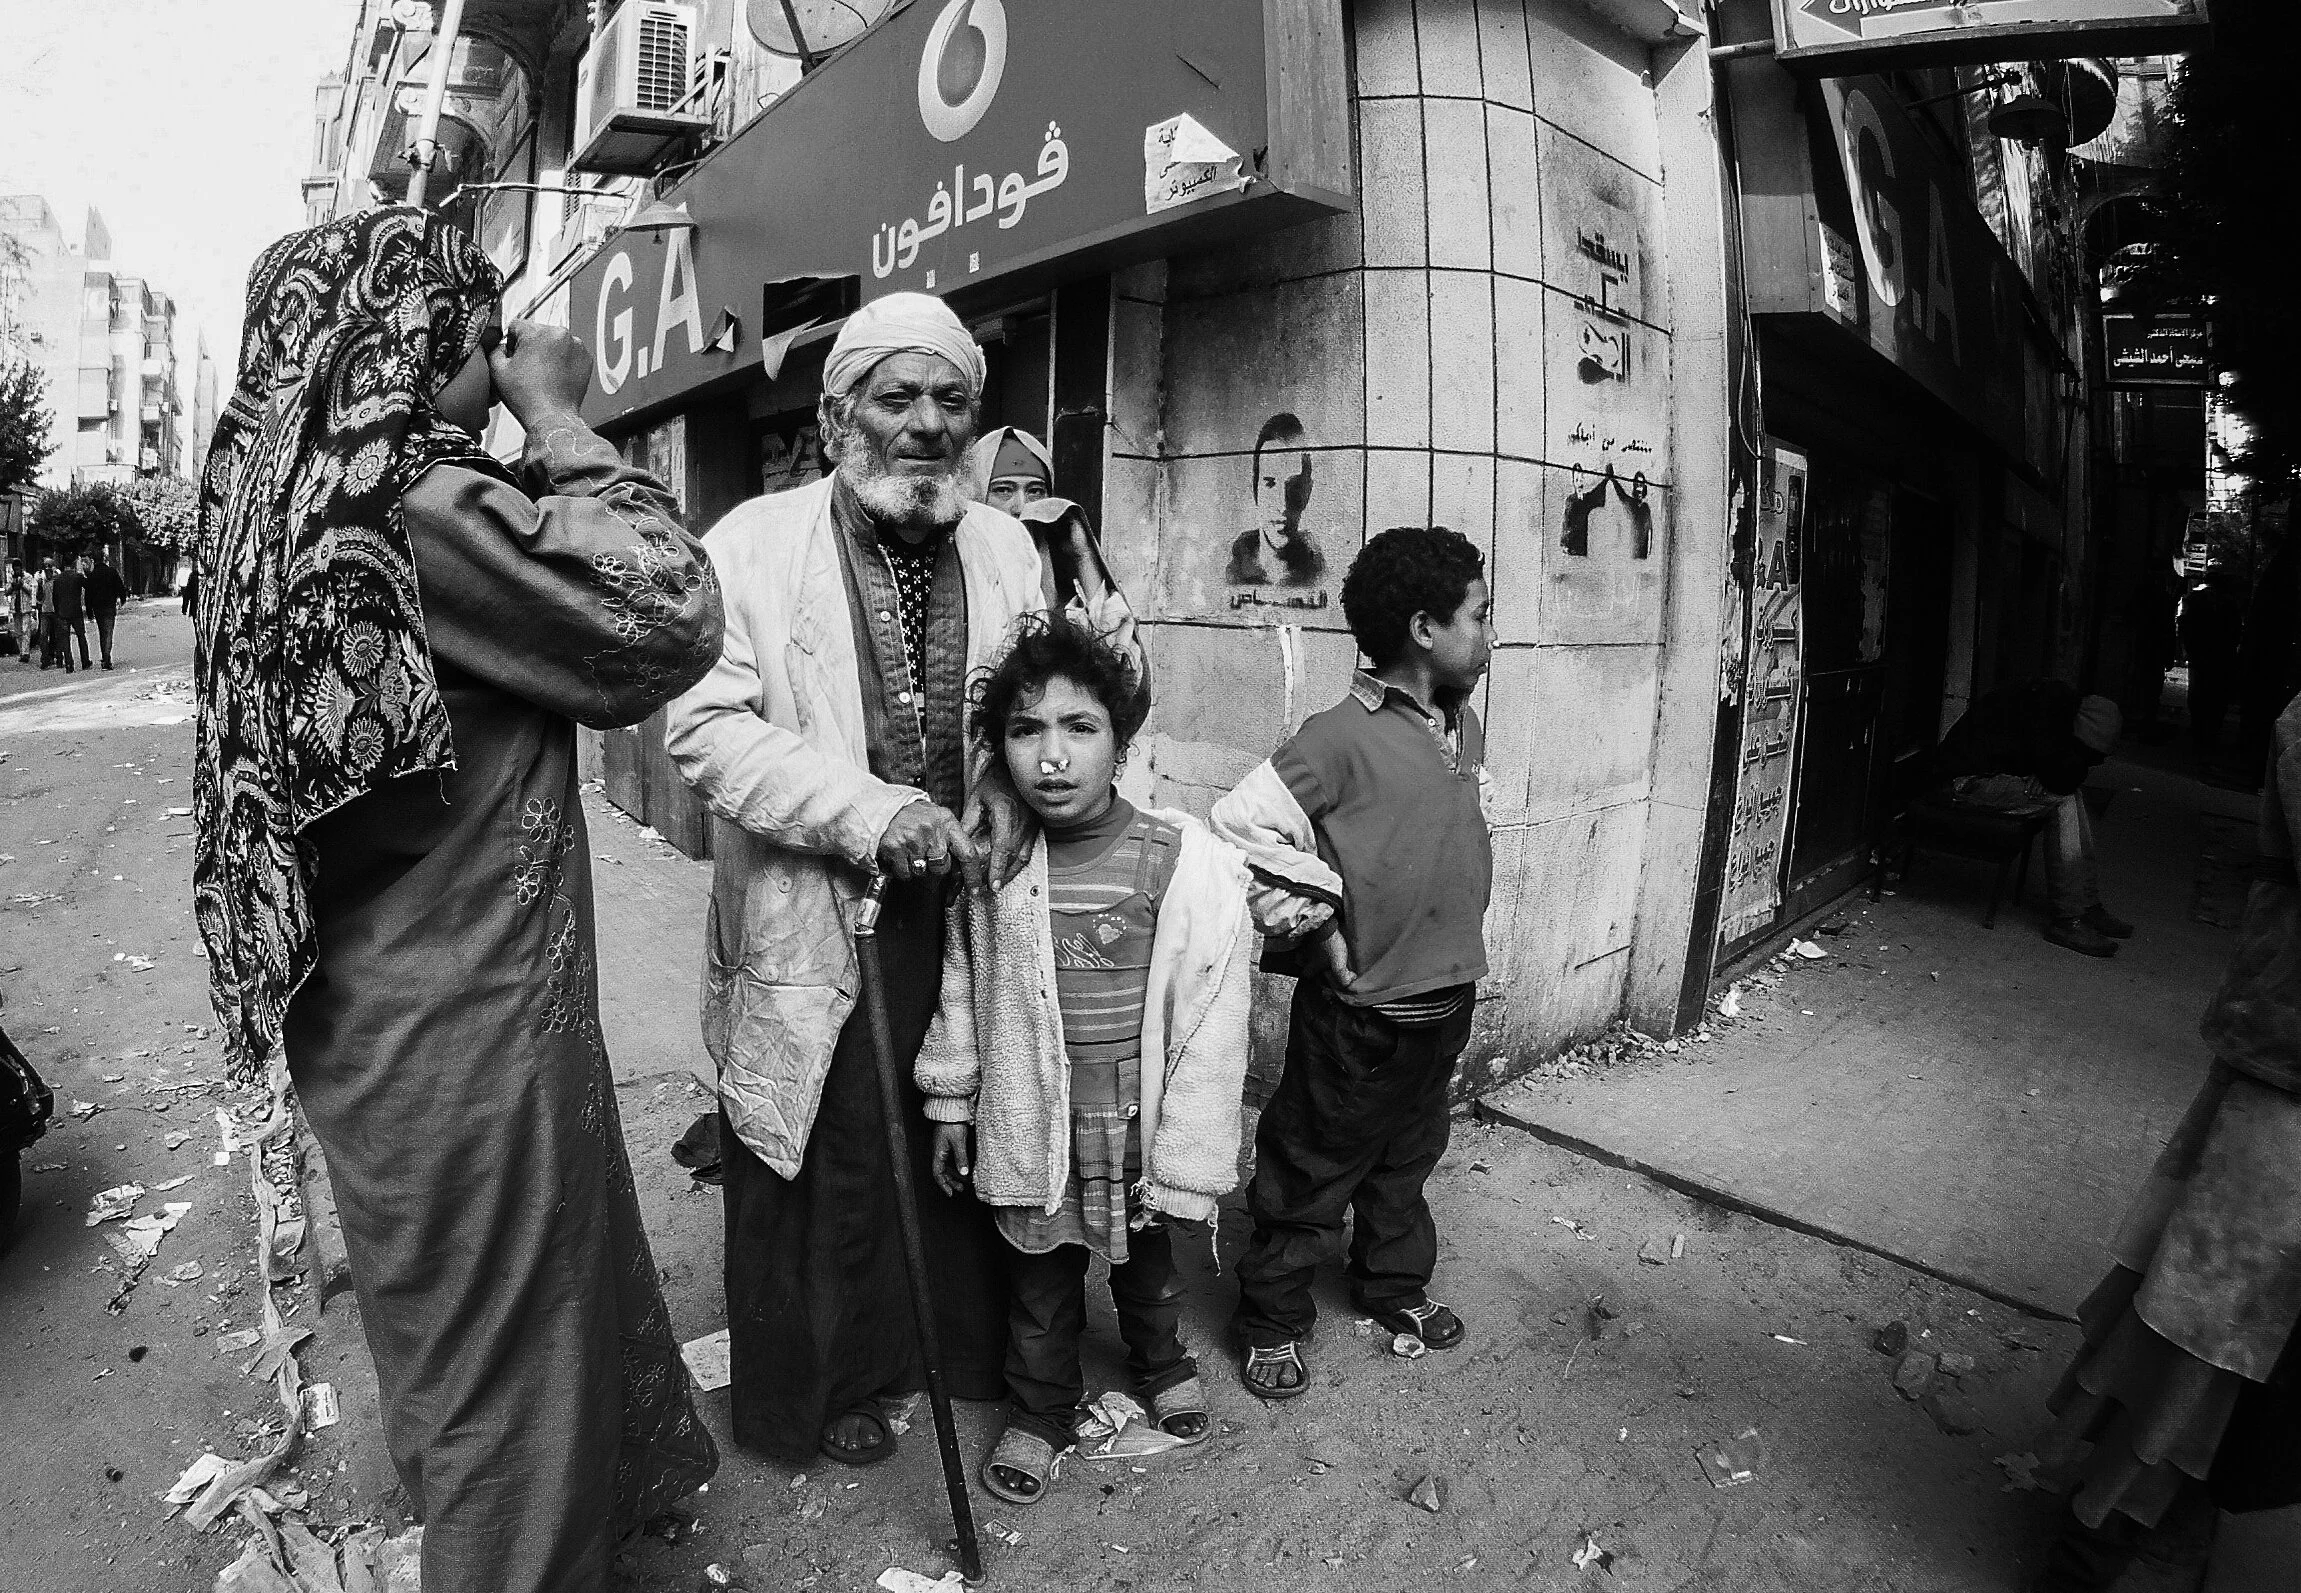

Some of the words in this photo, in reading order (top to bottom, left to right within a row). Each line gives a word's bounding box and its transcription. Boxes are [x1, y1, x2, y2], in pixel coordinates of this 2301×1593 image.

[1165, 166, 1217, 200] الكمبيوتر
[1577, 227, 1628, 284] يسقط
[2149, 345, 2173, 365] أحمد
